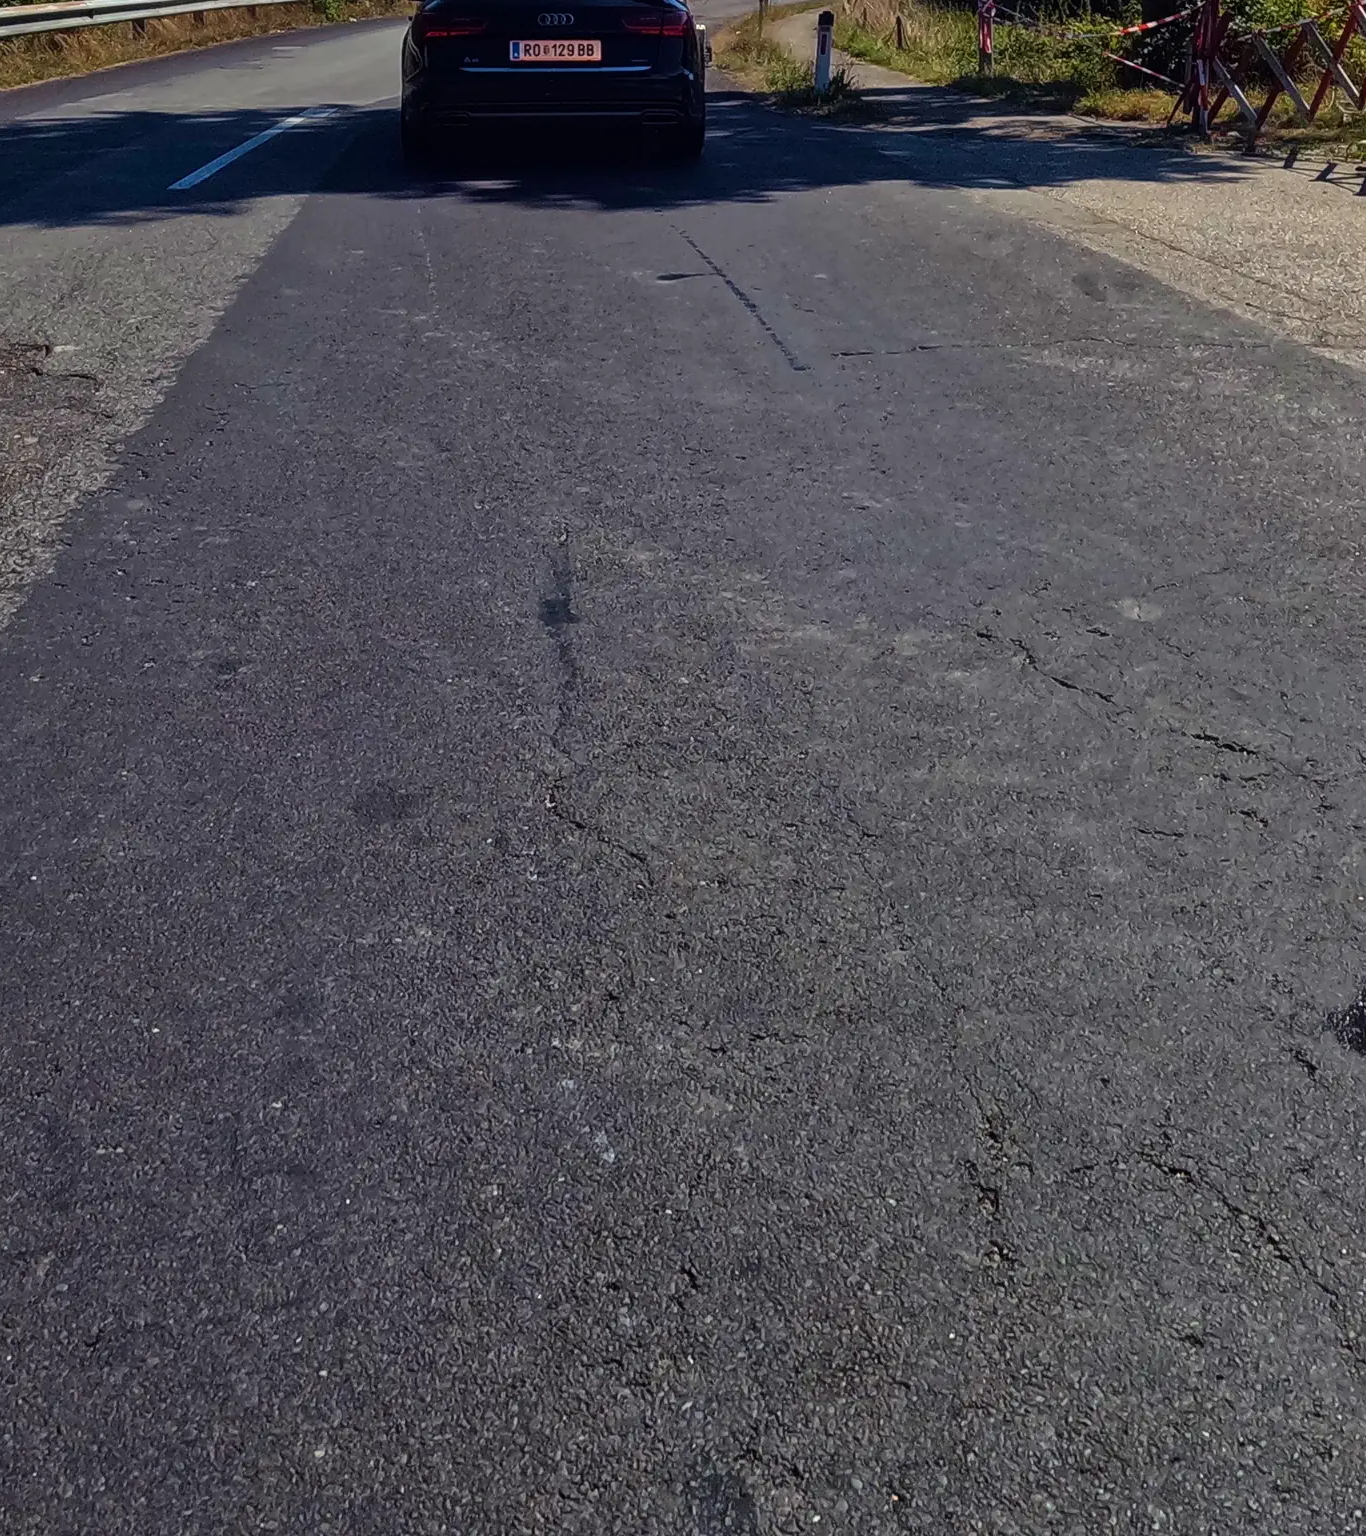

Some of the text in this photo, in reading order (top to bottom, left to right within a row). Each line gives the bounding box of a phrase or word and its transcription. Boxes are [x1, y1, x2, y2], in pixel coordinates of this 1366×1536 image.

[523, 43, 541, 57] RO
[551, 43, 575, 56] 129
[578, 43, 595, 56] BB
